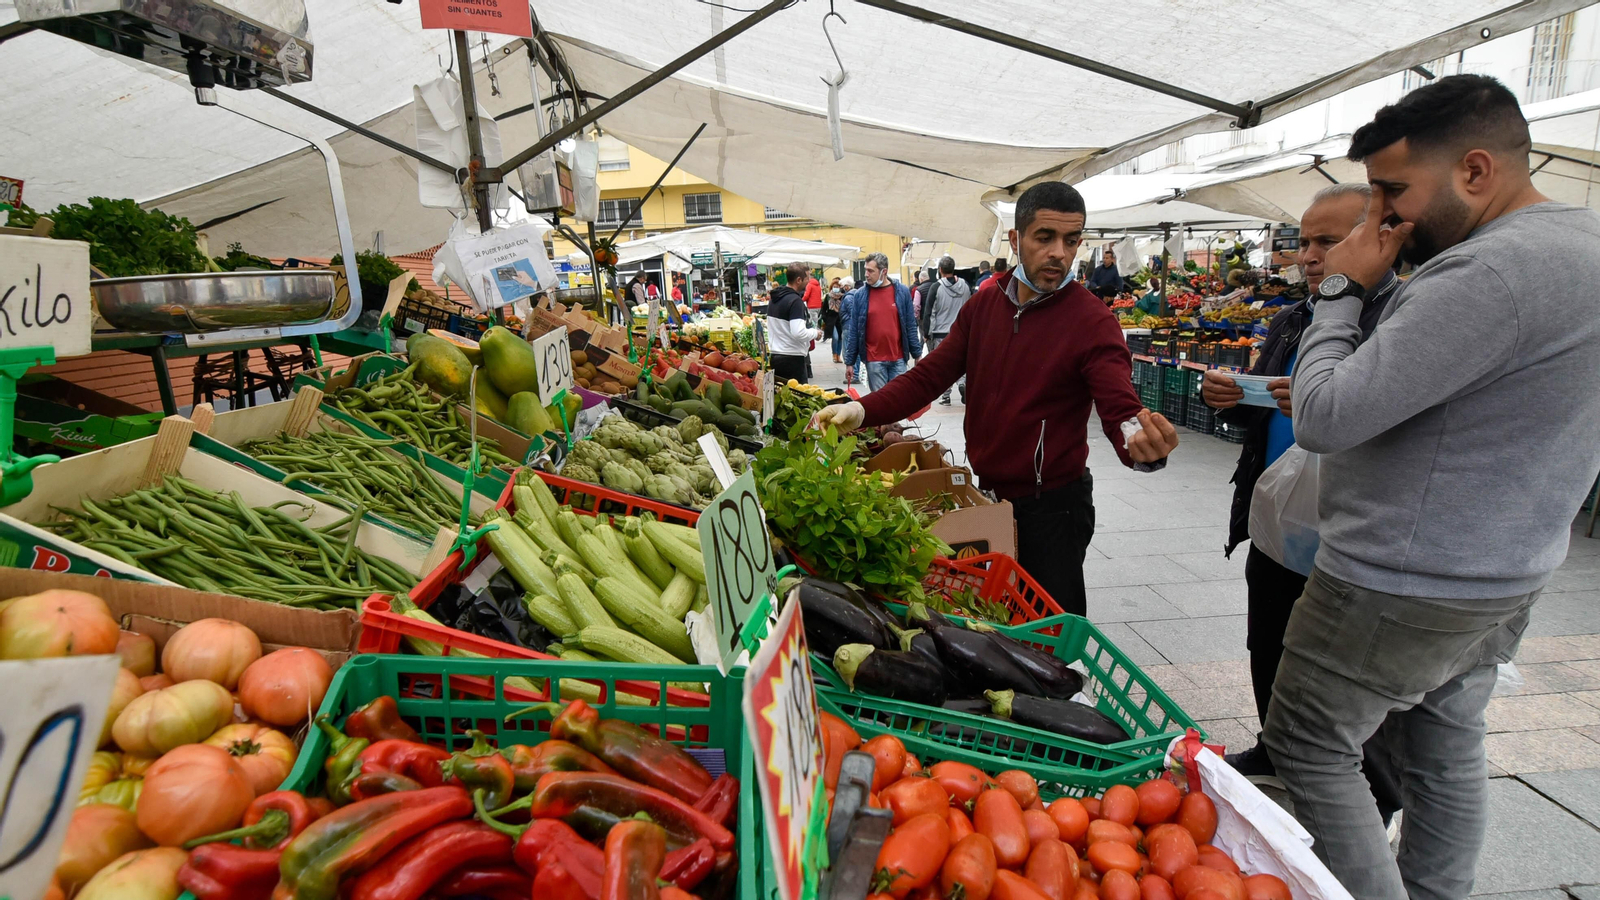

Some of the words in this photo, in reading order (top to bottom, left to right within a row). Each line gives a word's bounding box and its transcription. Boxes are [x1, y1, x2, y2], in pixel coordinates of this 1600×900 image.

[447, 5, 462, 13] SIN
[463, 7, 503, 18] GUANTES
[481, 246, 497, 256] PUEDE
[497, 241, 516, 251] PAGAR
[516, 237, 529, 246] CON
[609, 360, 636, 377] MONTER
[49, 427, 96, 443] Kiwi
